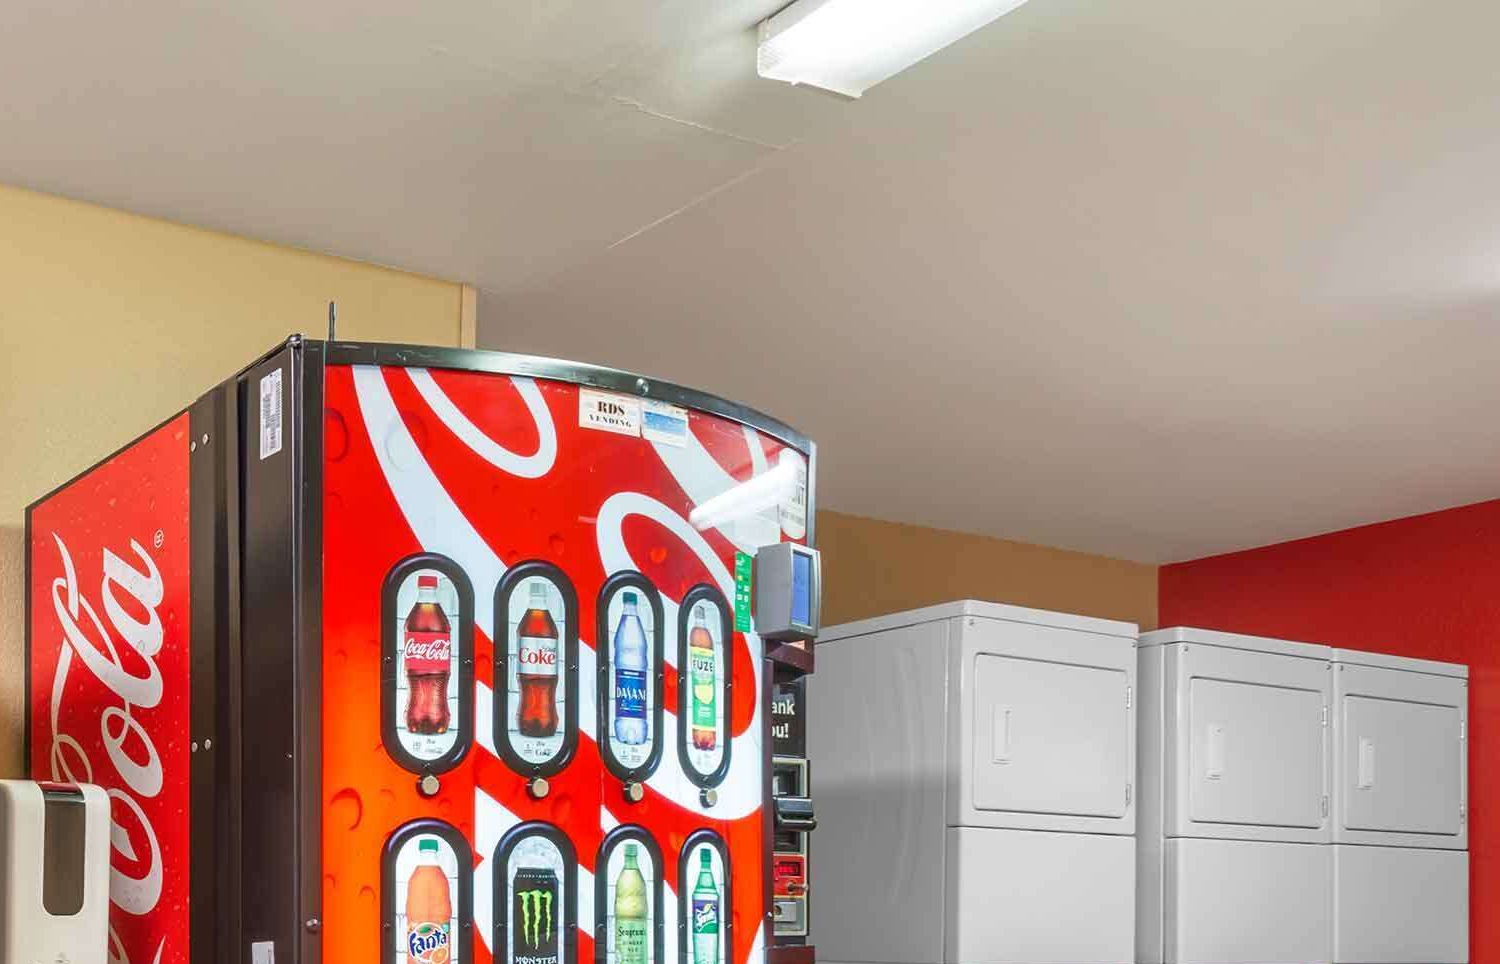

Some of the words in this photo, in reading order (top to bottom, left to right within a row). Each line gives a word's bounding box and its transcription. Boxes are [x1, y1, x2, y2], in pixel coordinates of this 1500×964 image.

[597, 400, 626, 416] RDS
[588, 413, 632, 428] VENDING
[403, 638, 451, 660] Coca-Cola
[518, 646, 556, 665] Coke
[692, 658, 714, 672] FUZE
[771, 701, 796, 715] ank
